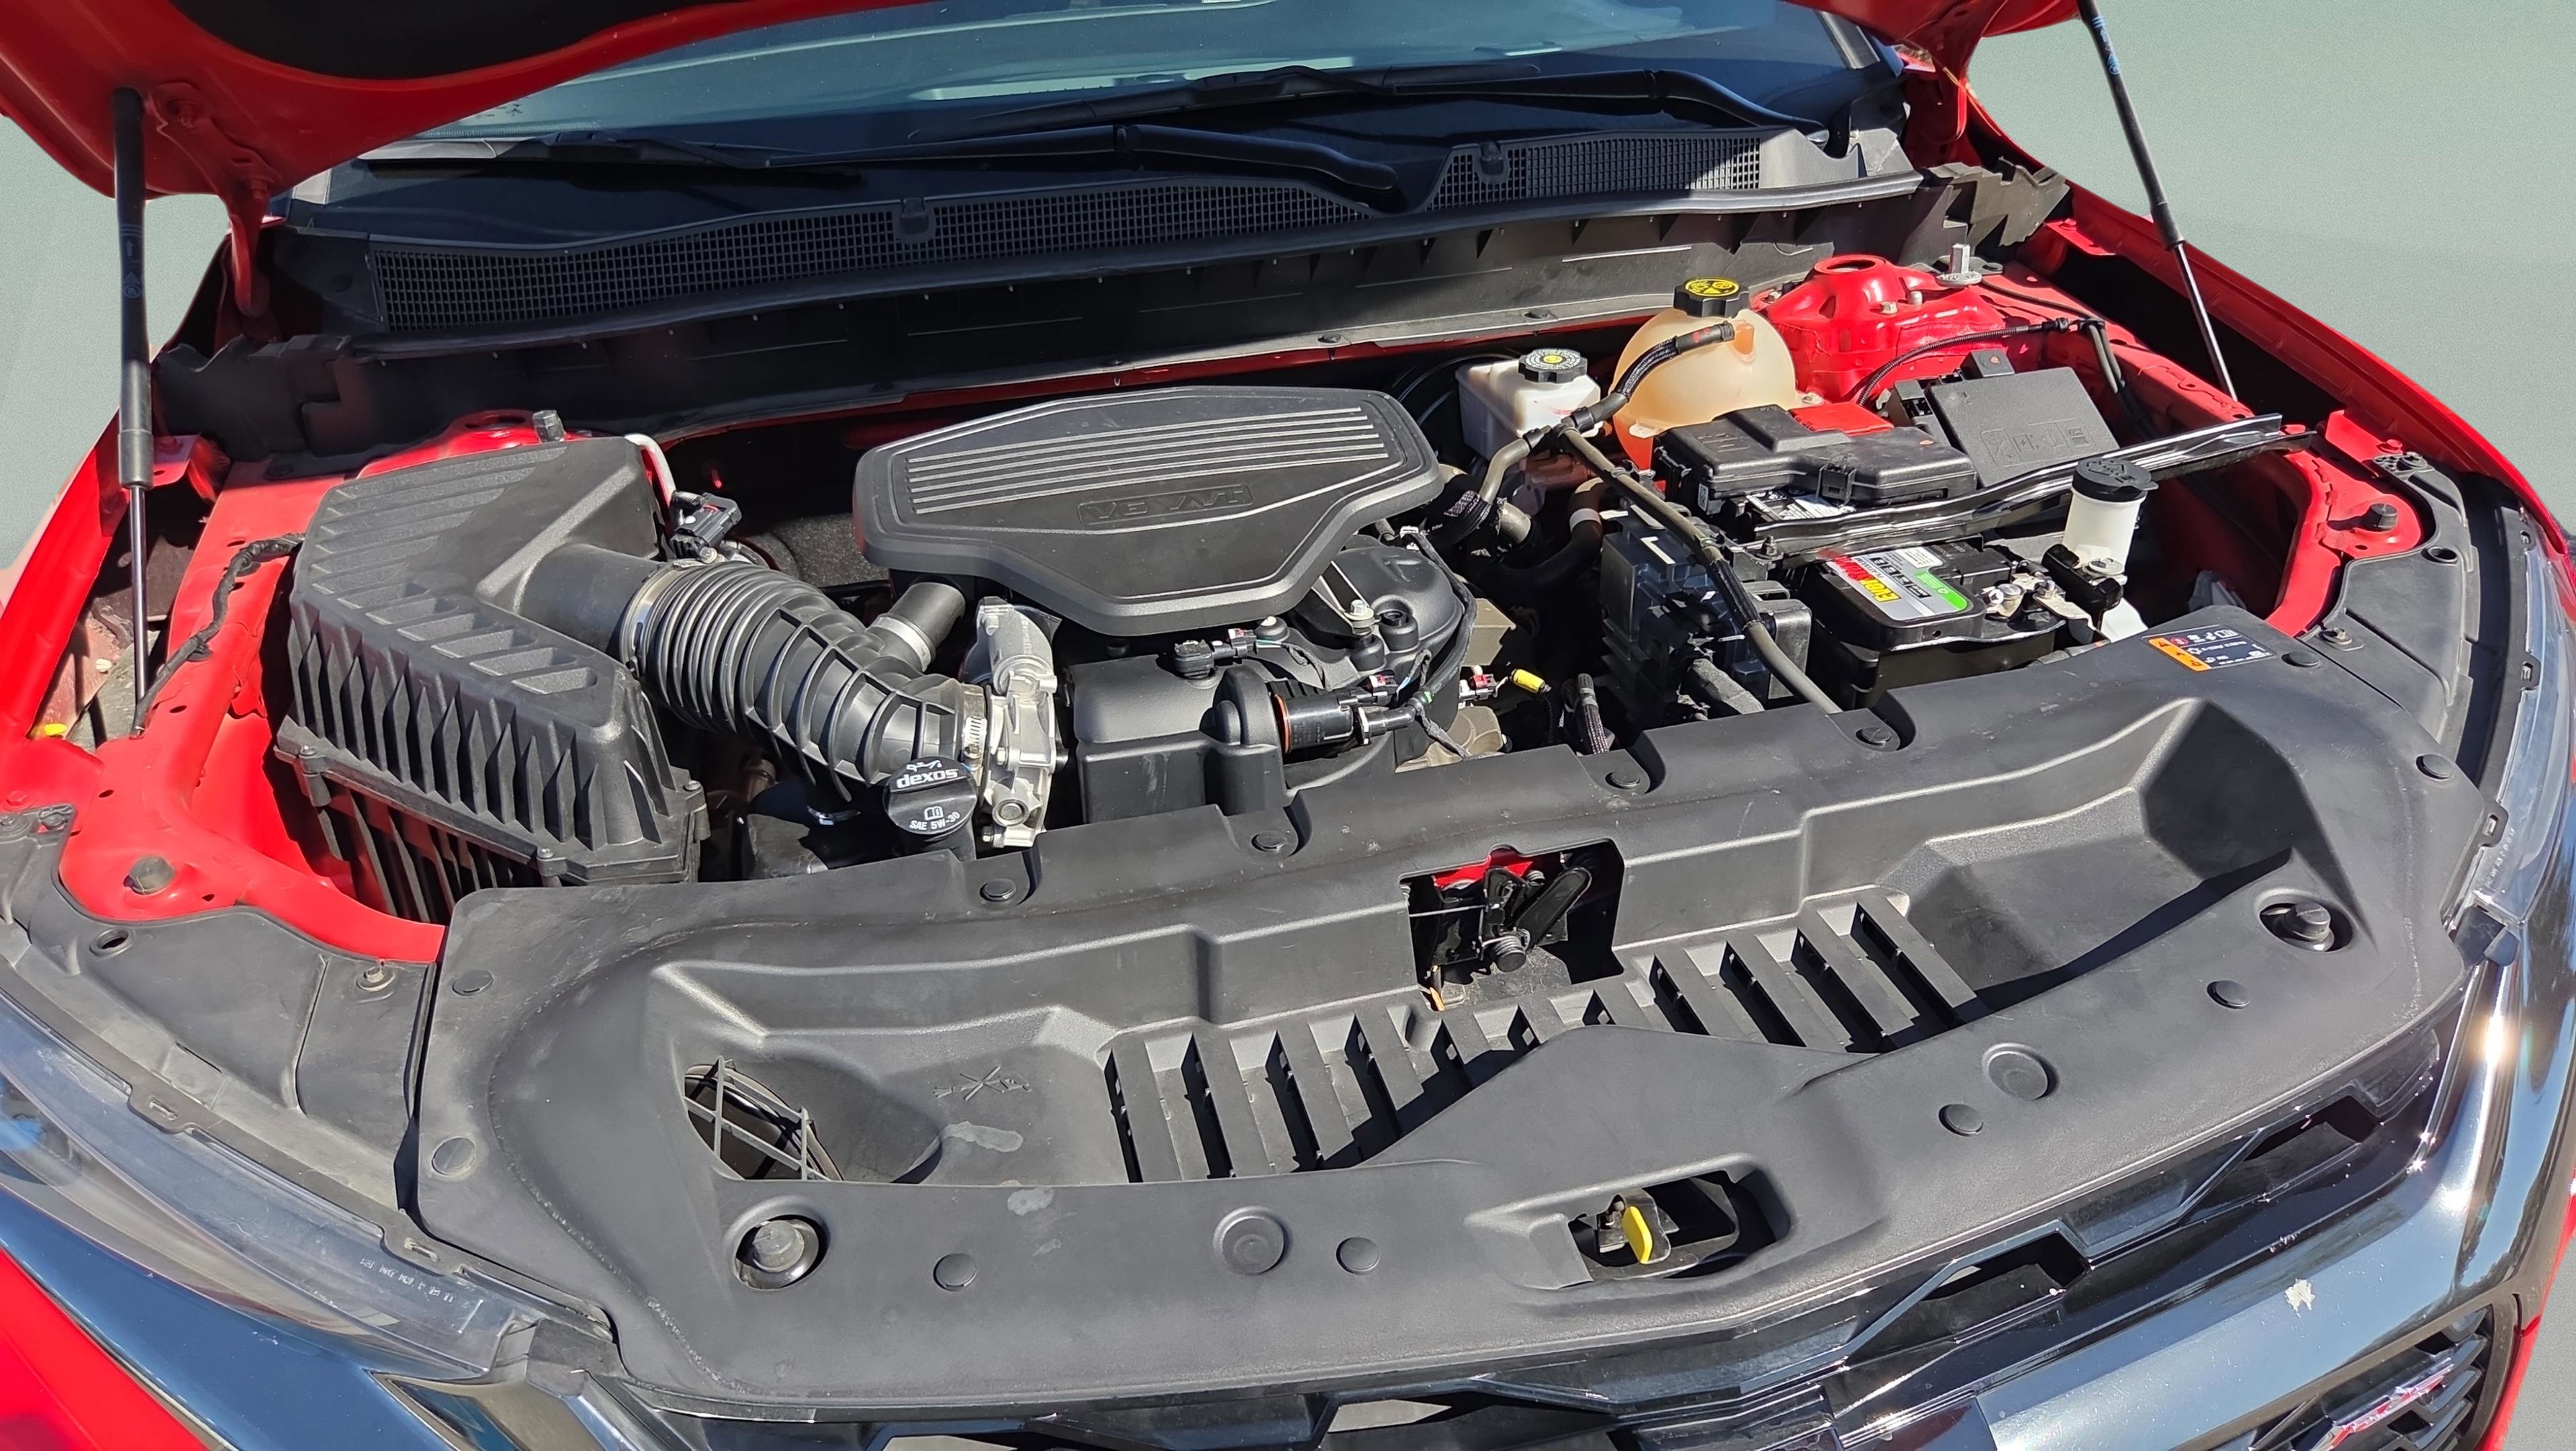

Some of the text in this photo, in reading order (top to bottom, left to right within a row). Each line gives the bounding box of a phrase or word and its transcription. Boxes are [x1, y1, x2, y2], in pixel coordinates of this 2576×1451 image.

[1087, 490, 1244, 520] V6 VVT
[896, 768, 960, 789] dexos
[909, 811, 960, 830] SAE 5W-30
